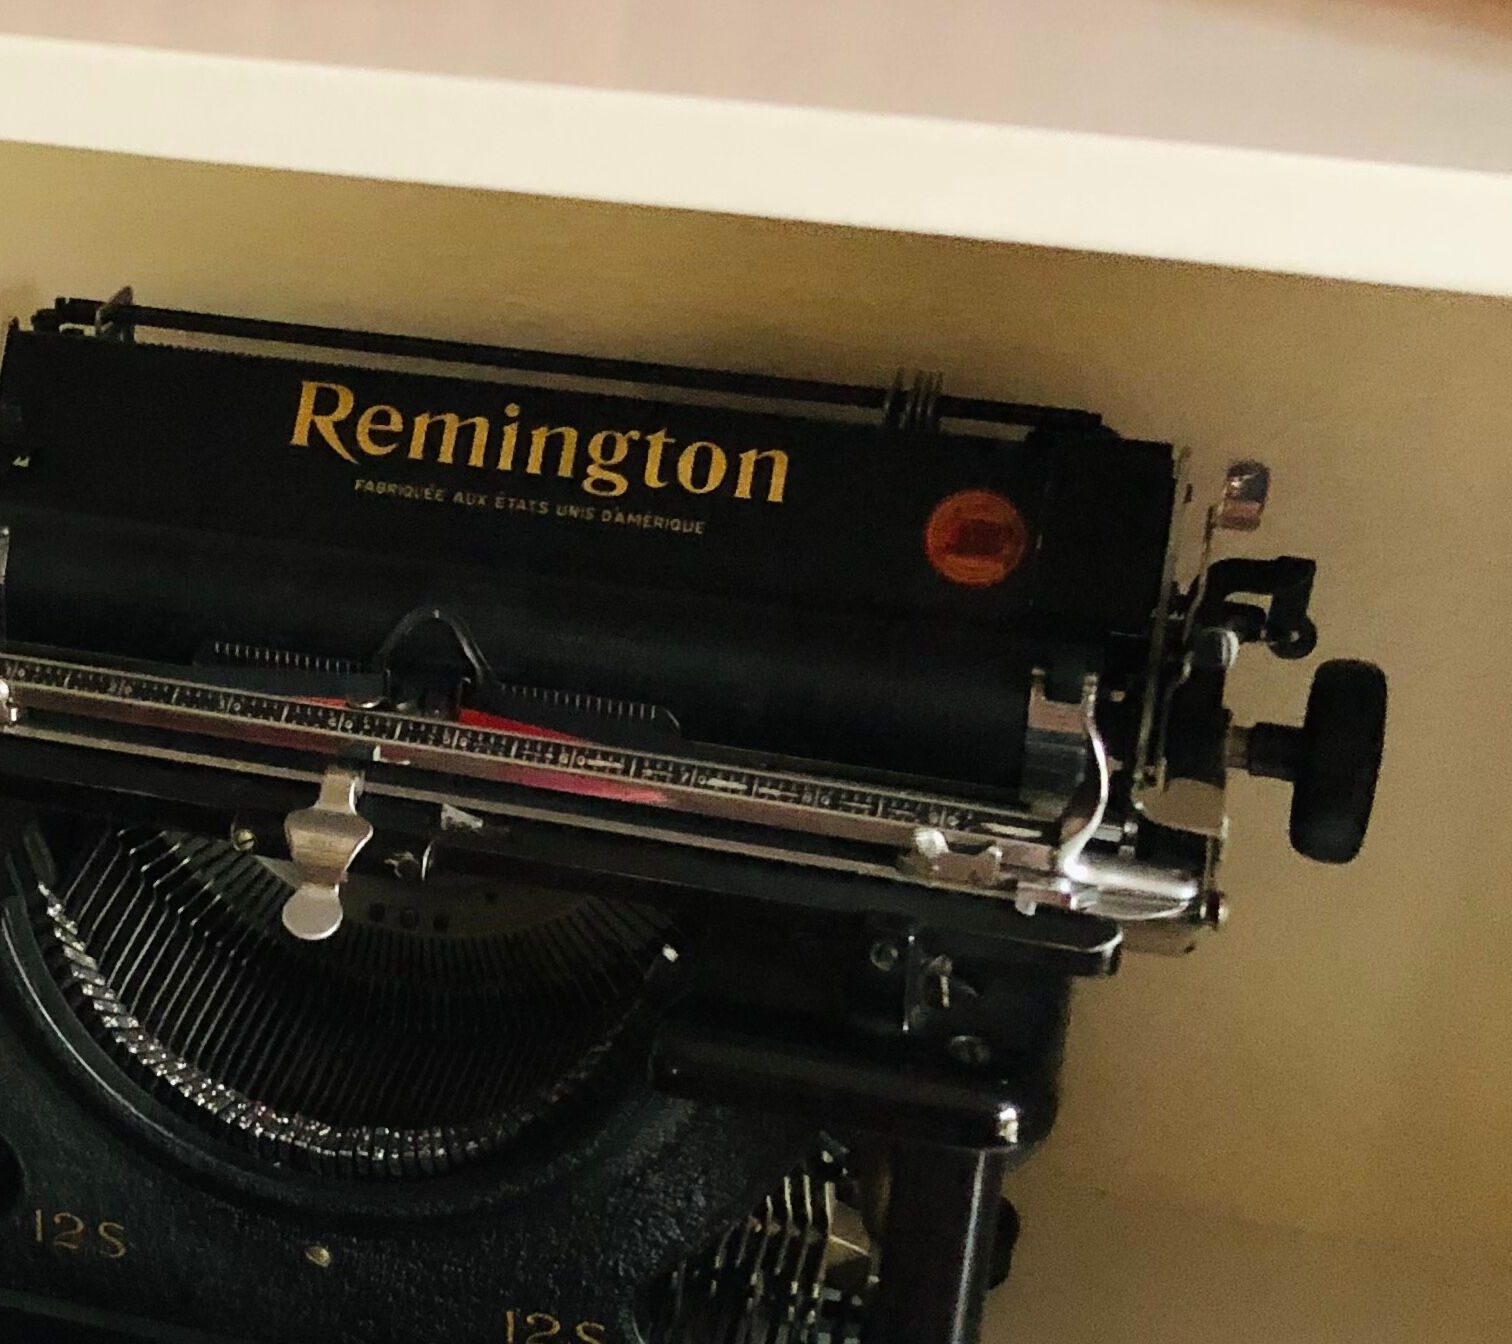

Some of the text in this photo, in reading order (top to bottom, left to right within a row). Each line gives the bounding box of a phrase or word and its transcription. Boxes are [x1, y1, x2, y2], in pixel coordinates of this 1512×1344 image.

[289, 378, 790, 503] Remington
[452, 490, 487, 507] AUX
[556, 505, 594, 520] UNIS
[34, 1208, 126, 1258] 12S
